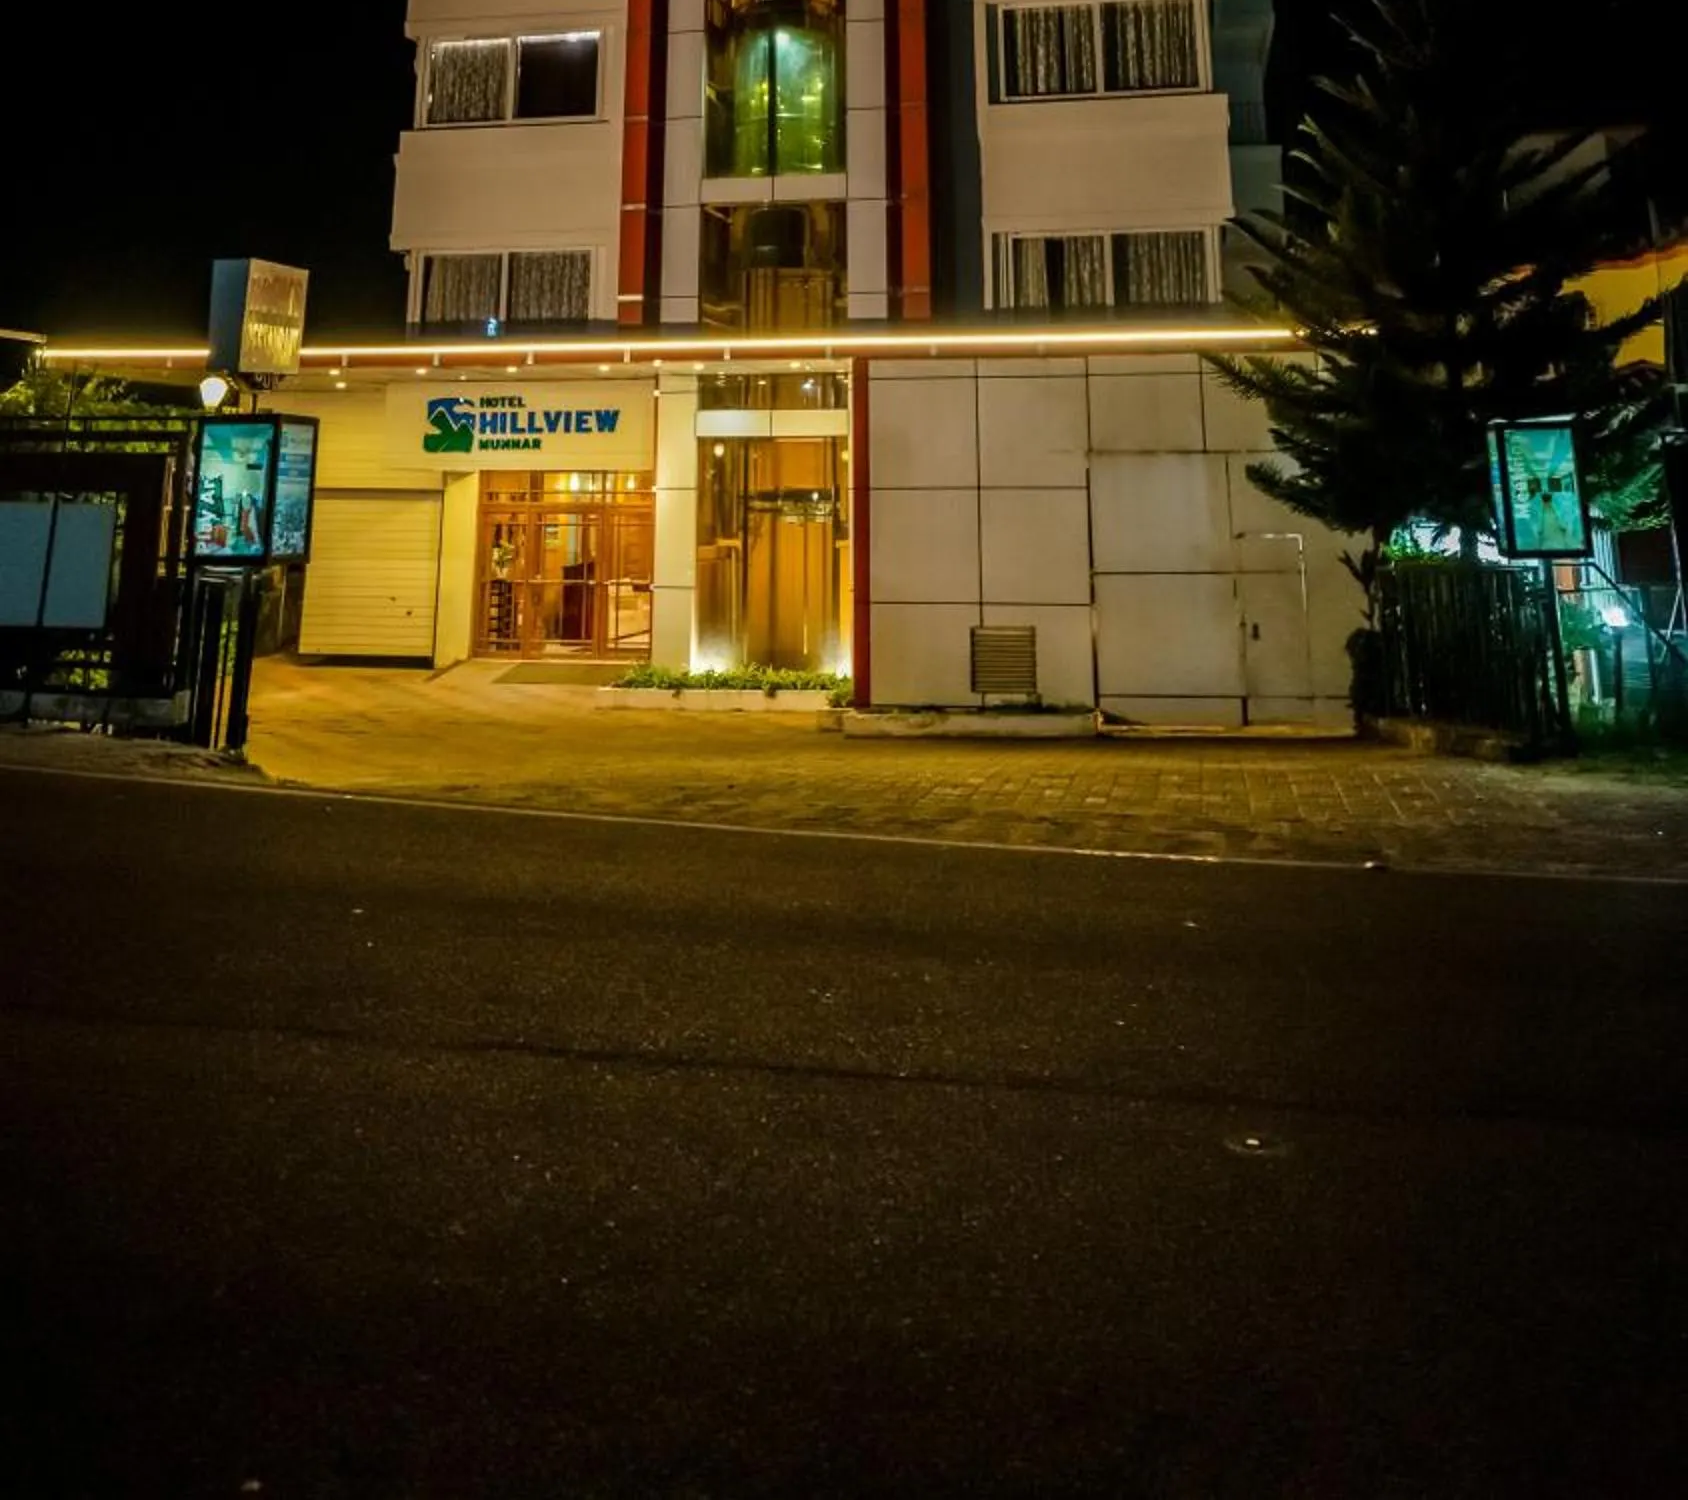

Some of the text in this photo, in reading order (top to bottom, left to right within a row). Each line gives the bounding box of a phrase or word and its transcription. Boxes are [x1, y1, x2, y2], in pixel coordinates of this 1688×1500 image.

[479, 396, 526, 408] HOTEL
[479, 410, 620, 434] HILLVIEW
[479, 438, 542, 450] MUNNAR
